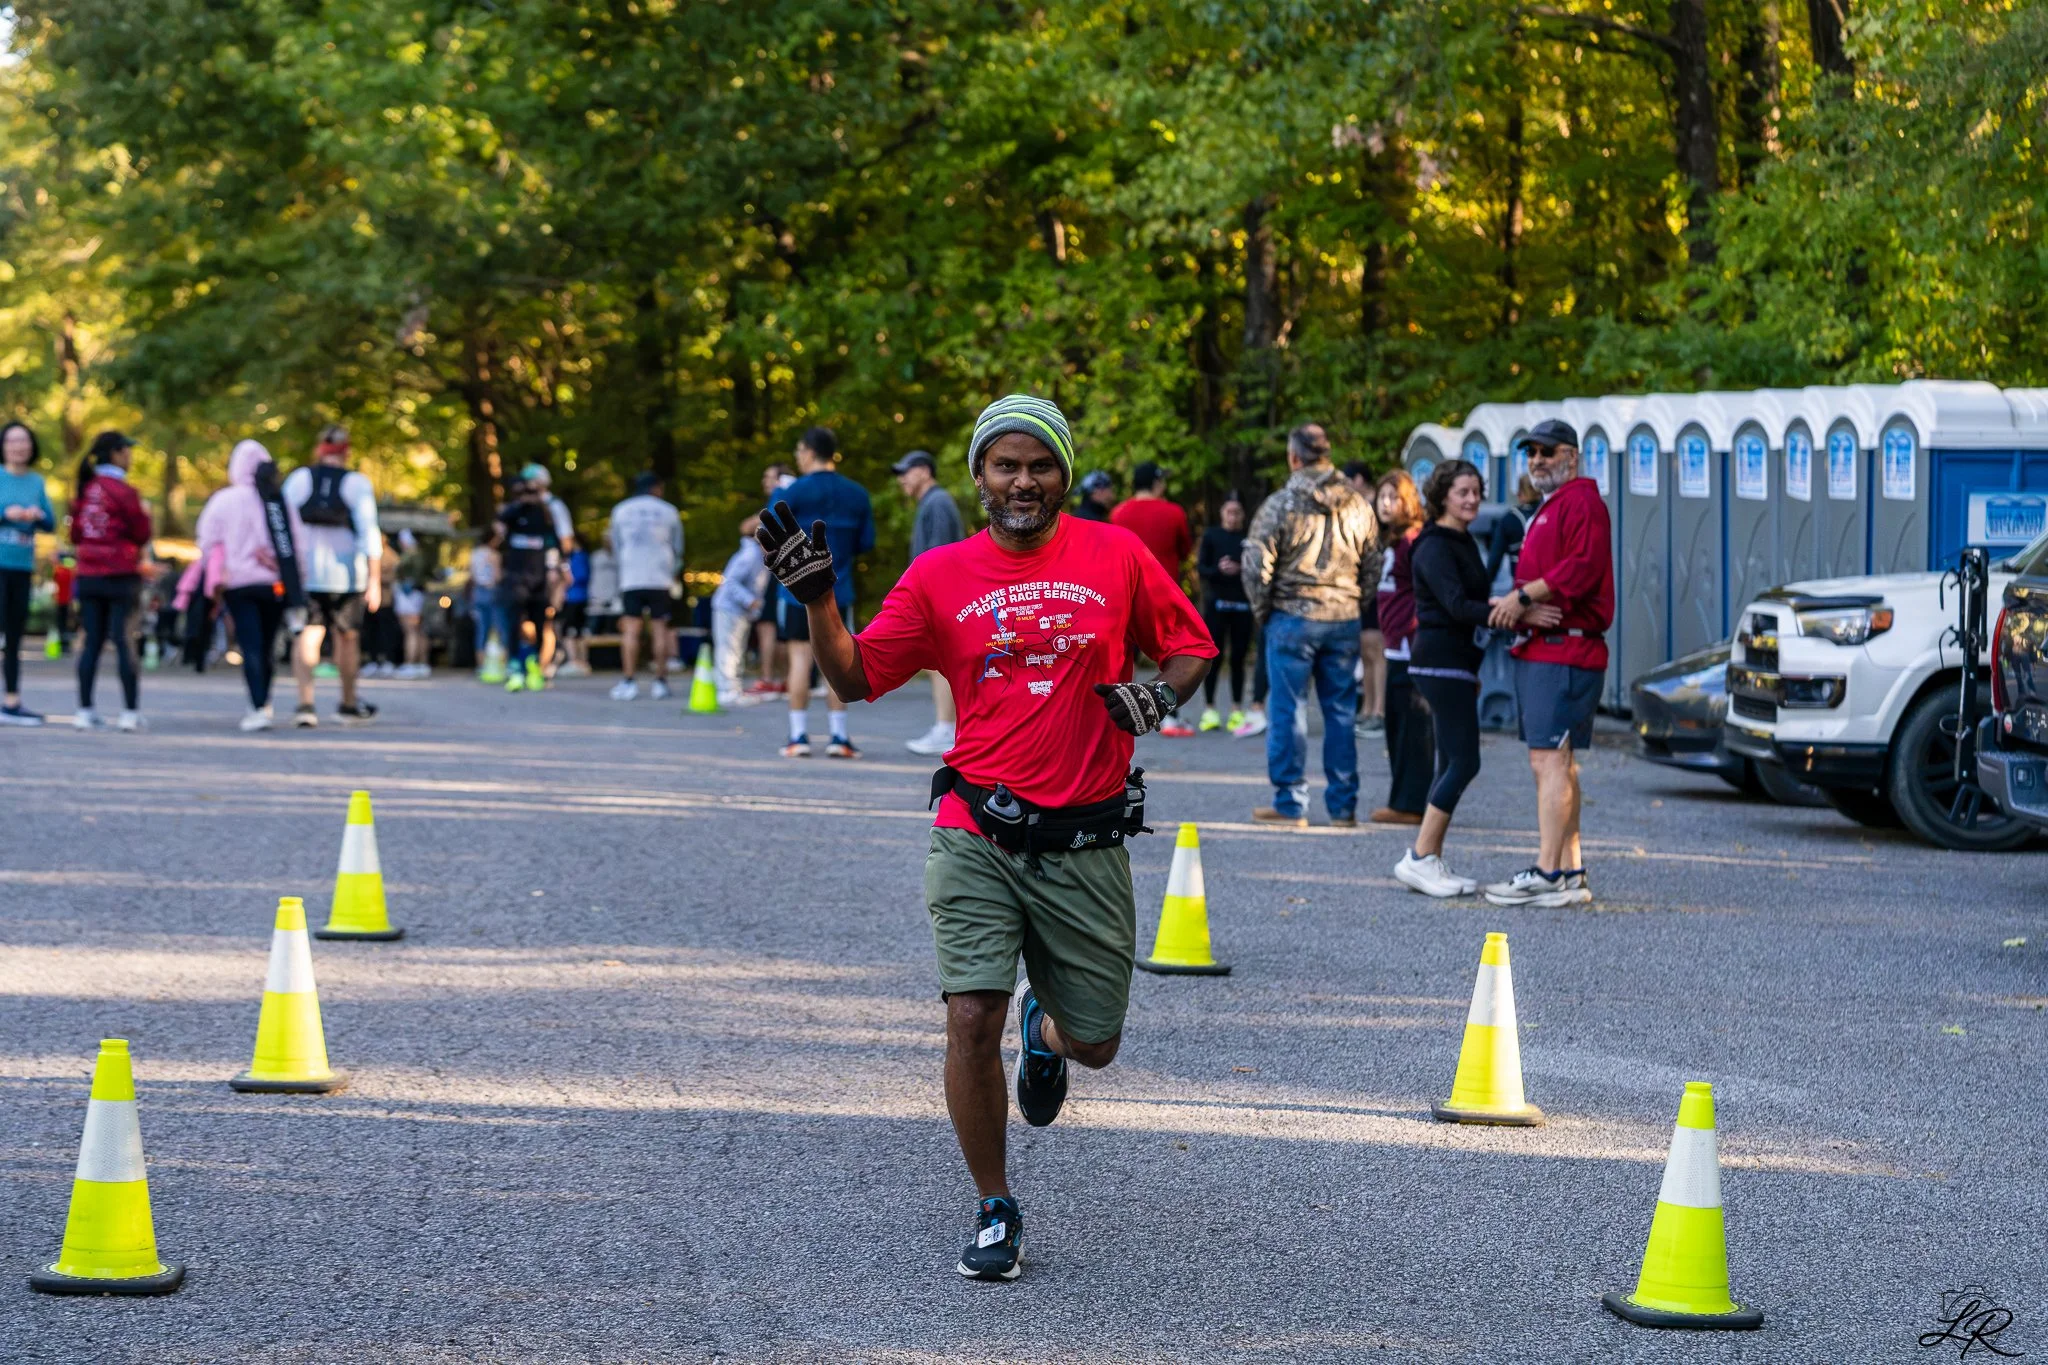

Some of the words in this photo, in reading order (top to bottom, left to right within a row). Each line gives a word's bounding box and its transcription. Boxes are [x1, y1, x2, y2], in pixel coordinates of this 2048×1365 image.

[956, 601, 979, 622] 2024
[978, 588, 1007, 604] LANE
[1008, 581, 1050, 595] PURSER
[1053, 582, 1106, 606] MEMORIAL
[975, 597, 1007, 617] ROAD
[1009, 590, 1041, 605] RACE
[1043, 589, 1087, 605] SERIES
